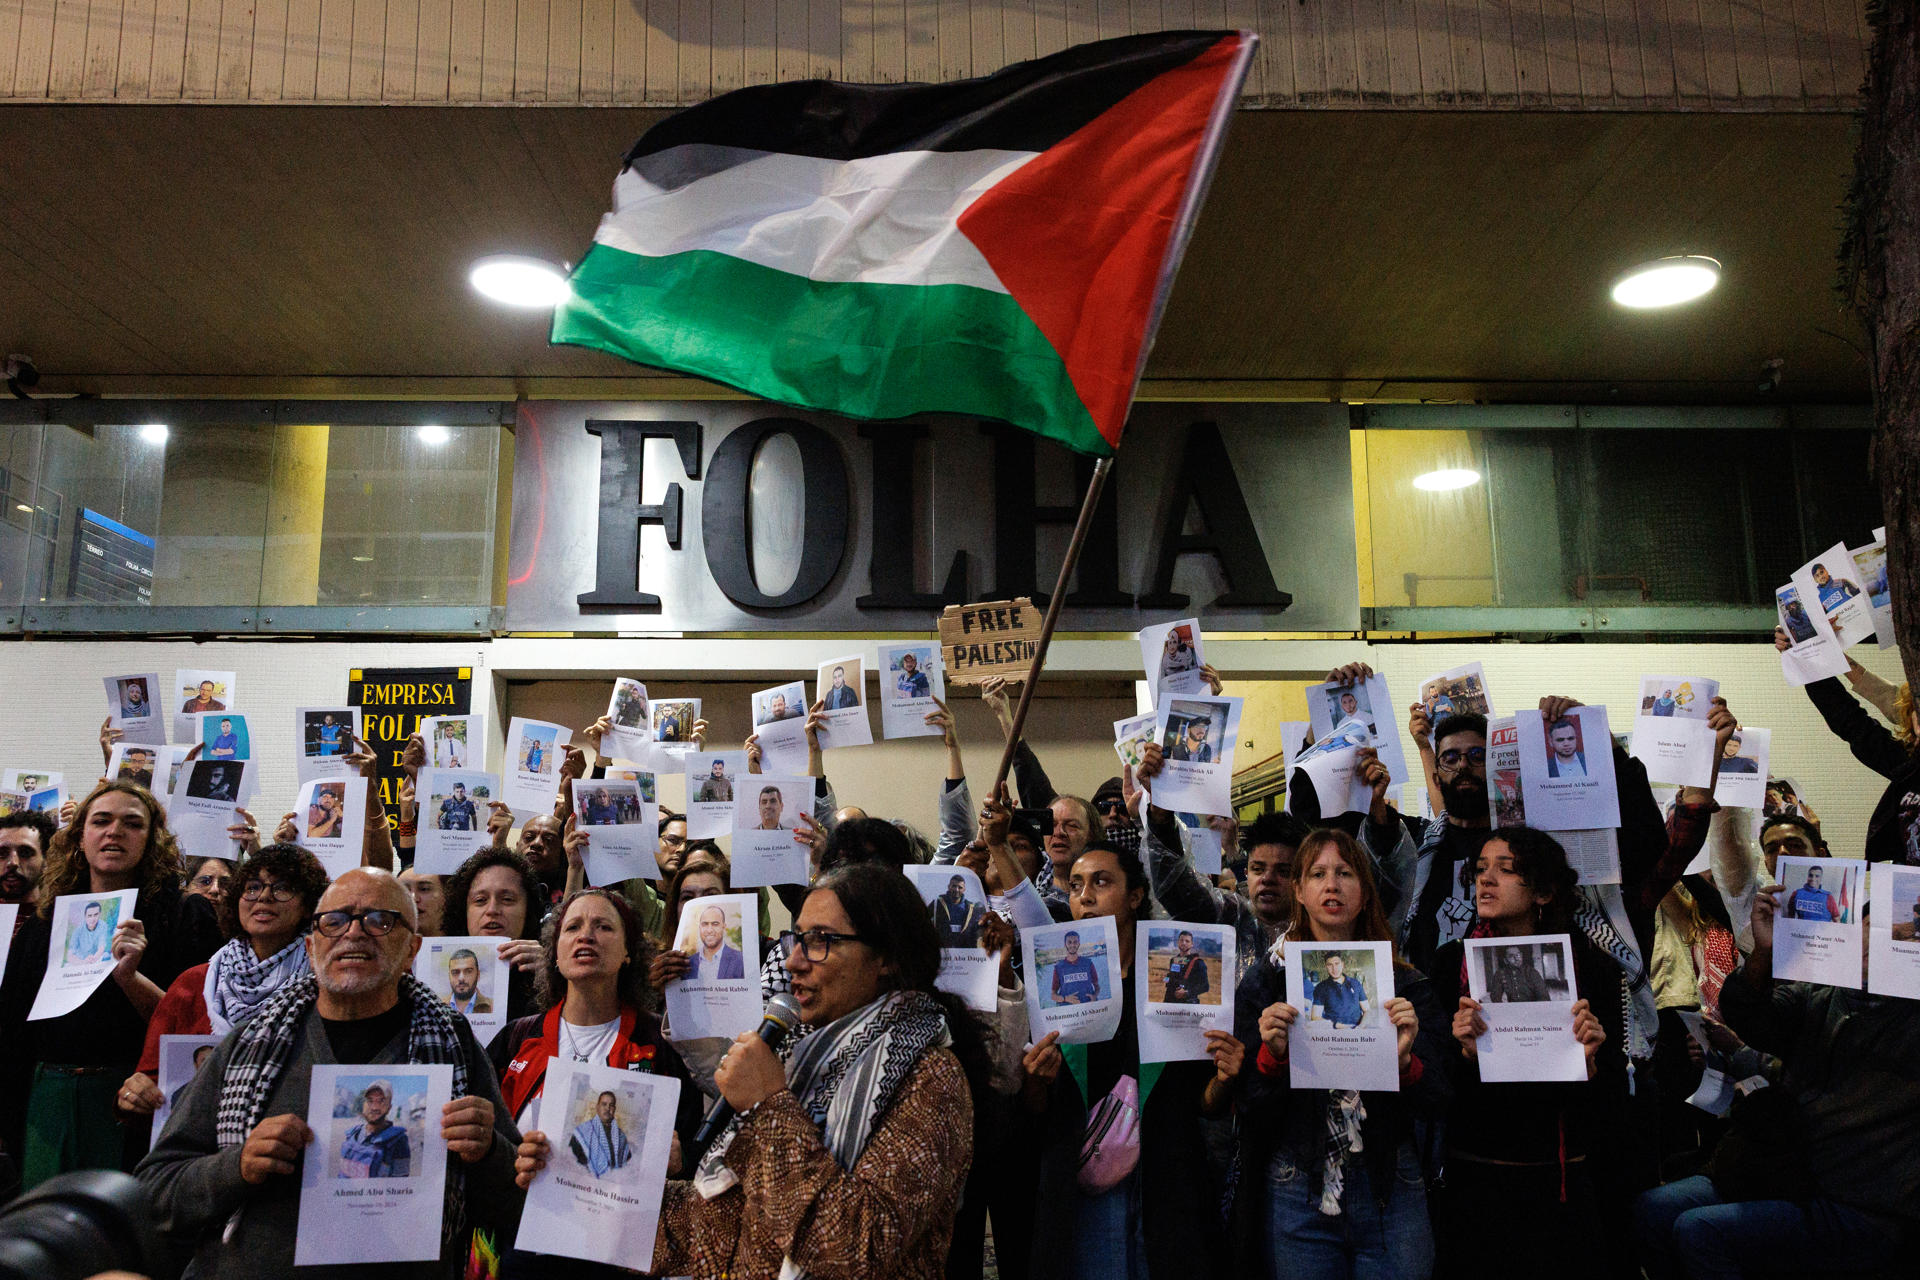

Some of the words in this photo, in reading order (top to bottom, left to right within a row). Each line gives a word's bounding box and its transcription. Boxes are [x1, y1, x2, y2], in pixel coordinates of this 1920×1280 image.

[577, 416, 1292, 615] FOLHA
[962, 608, 1023, 634] FREE
[953, 640, 1039, 669] PALESTIN
[362, 684, 455, 704] EMPRESA
[1496, 758, 1507, 767] de
[1508, 758, 1520, 766] cri
[1797, 900, 1824, 914] PRESS
[1064, 972, 1088, 983] PRESS
[334, 1188, 364, 1196] Ahmed
[366, 1188, 384, 1196] Abu
[594, 1188, 608, 1198] Abu
[610, 1192, 639, 1204] Hassira
